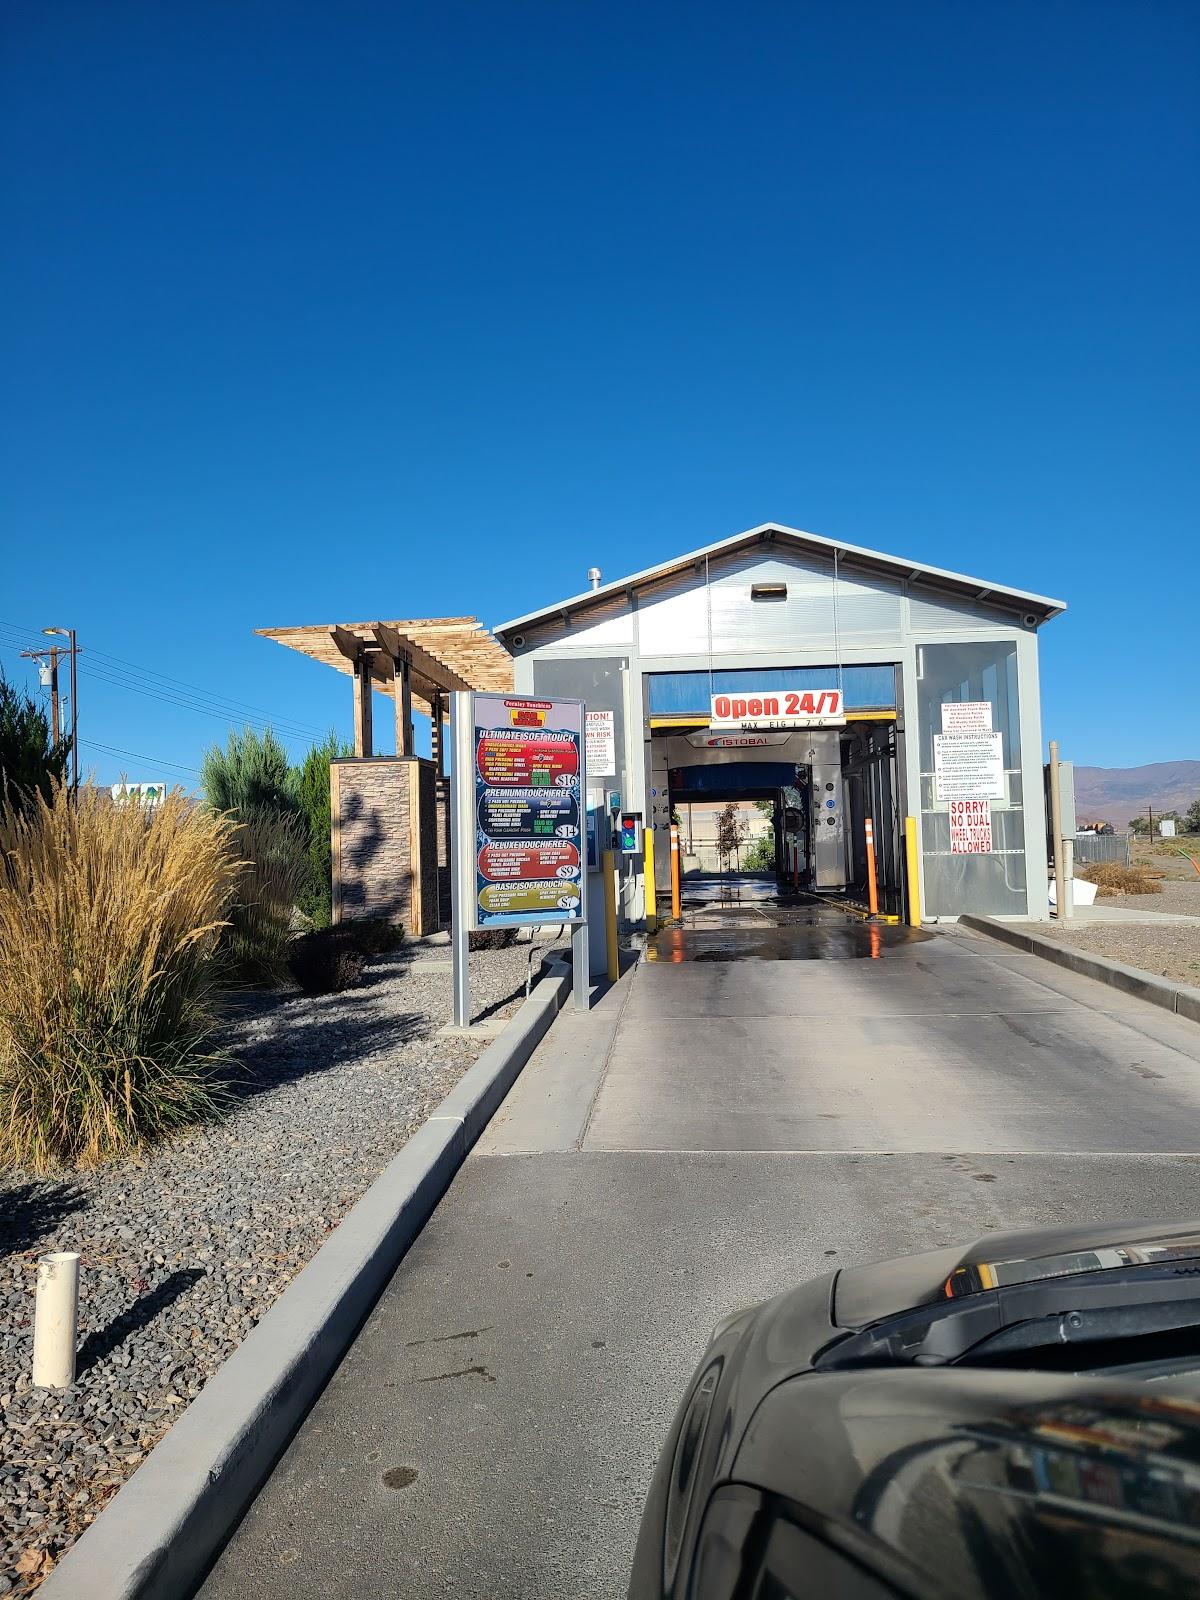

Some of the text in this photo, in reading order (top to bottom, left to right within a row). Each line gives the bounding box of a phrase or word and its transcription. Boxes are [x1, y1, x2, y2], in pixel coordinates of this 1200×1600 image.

[715, 692, 839, 719] Open 24/7
[479, 730, 574, 743] ULTIMATE SOFT TOUCH
[722, 738, 768, 746] ISTOBAL
[557, 775, 576, 786] $16
[485, 789, 571, 797] PREMIUM TOUCH FREE
[952, 801, 988, 814] SORRY!
[952, 814, 990, 827] NO DUAL
[557, 827, 575, 837] $14
[951, 828, 990, 841] WHEEL TRUCKS
[490, 840, 568, 850] DELUXE TOUCH FREE
[952, 841, 990, 853] ALLOWED
[561, 866, 573, 877] $9
[495, 881, 563, 891] BASIC SOFT TOUCH
[561, 897, 572, 908] $7
